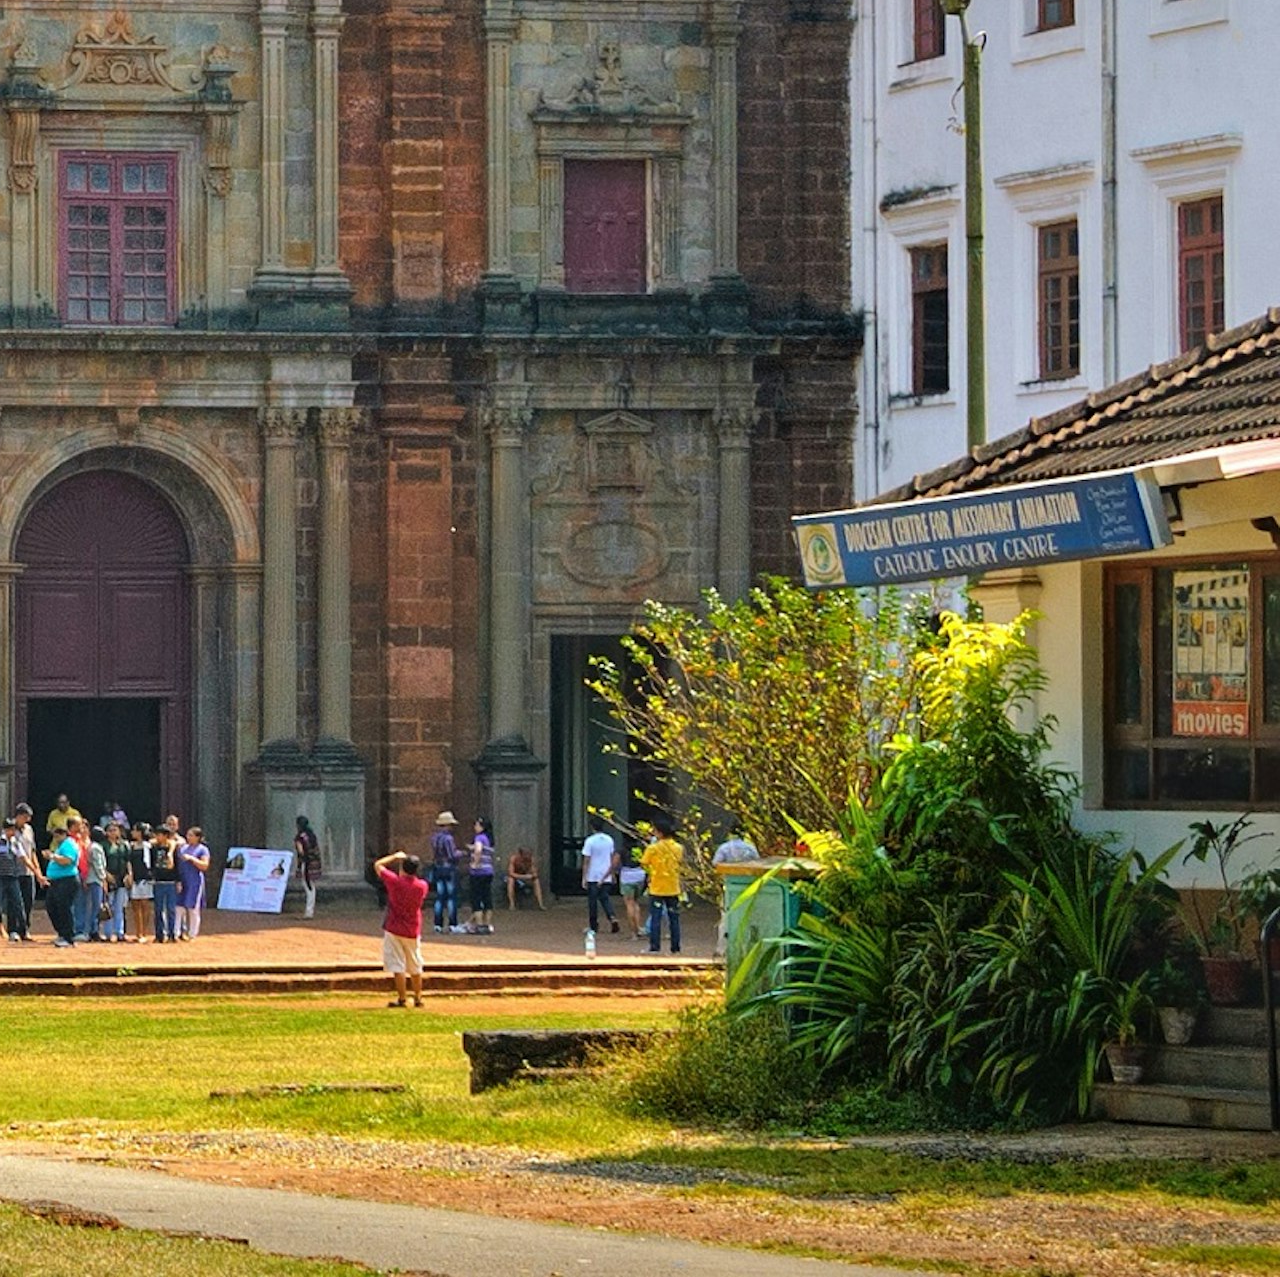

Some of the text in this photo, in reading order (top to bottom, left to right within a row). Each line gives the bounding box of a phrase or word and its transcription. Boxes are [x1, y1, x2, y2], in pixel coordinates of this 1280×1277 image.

[844, 519, 893, 552] DIOCESAN
[892, 513, 930, 546] CENTRE
[929, 510, 953, 542] FOR
[952, 500, 1016, 538] MISSIONARY
[1017, 491, 1081, 529] ANIMATION
[874, 549, 940, 578] CATHOLIC
[1003, 533, 1060, 561] CENTRE
[1177, 707, 1244, 735] movies
